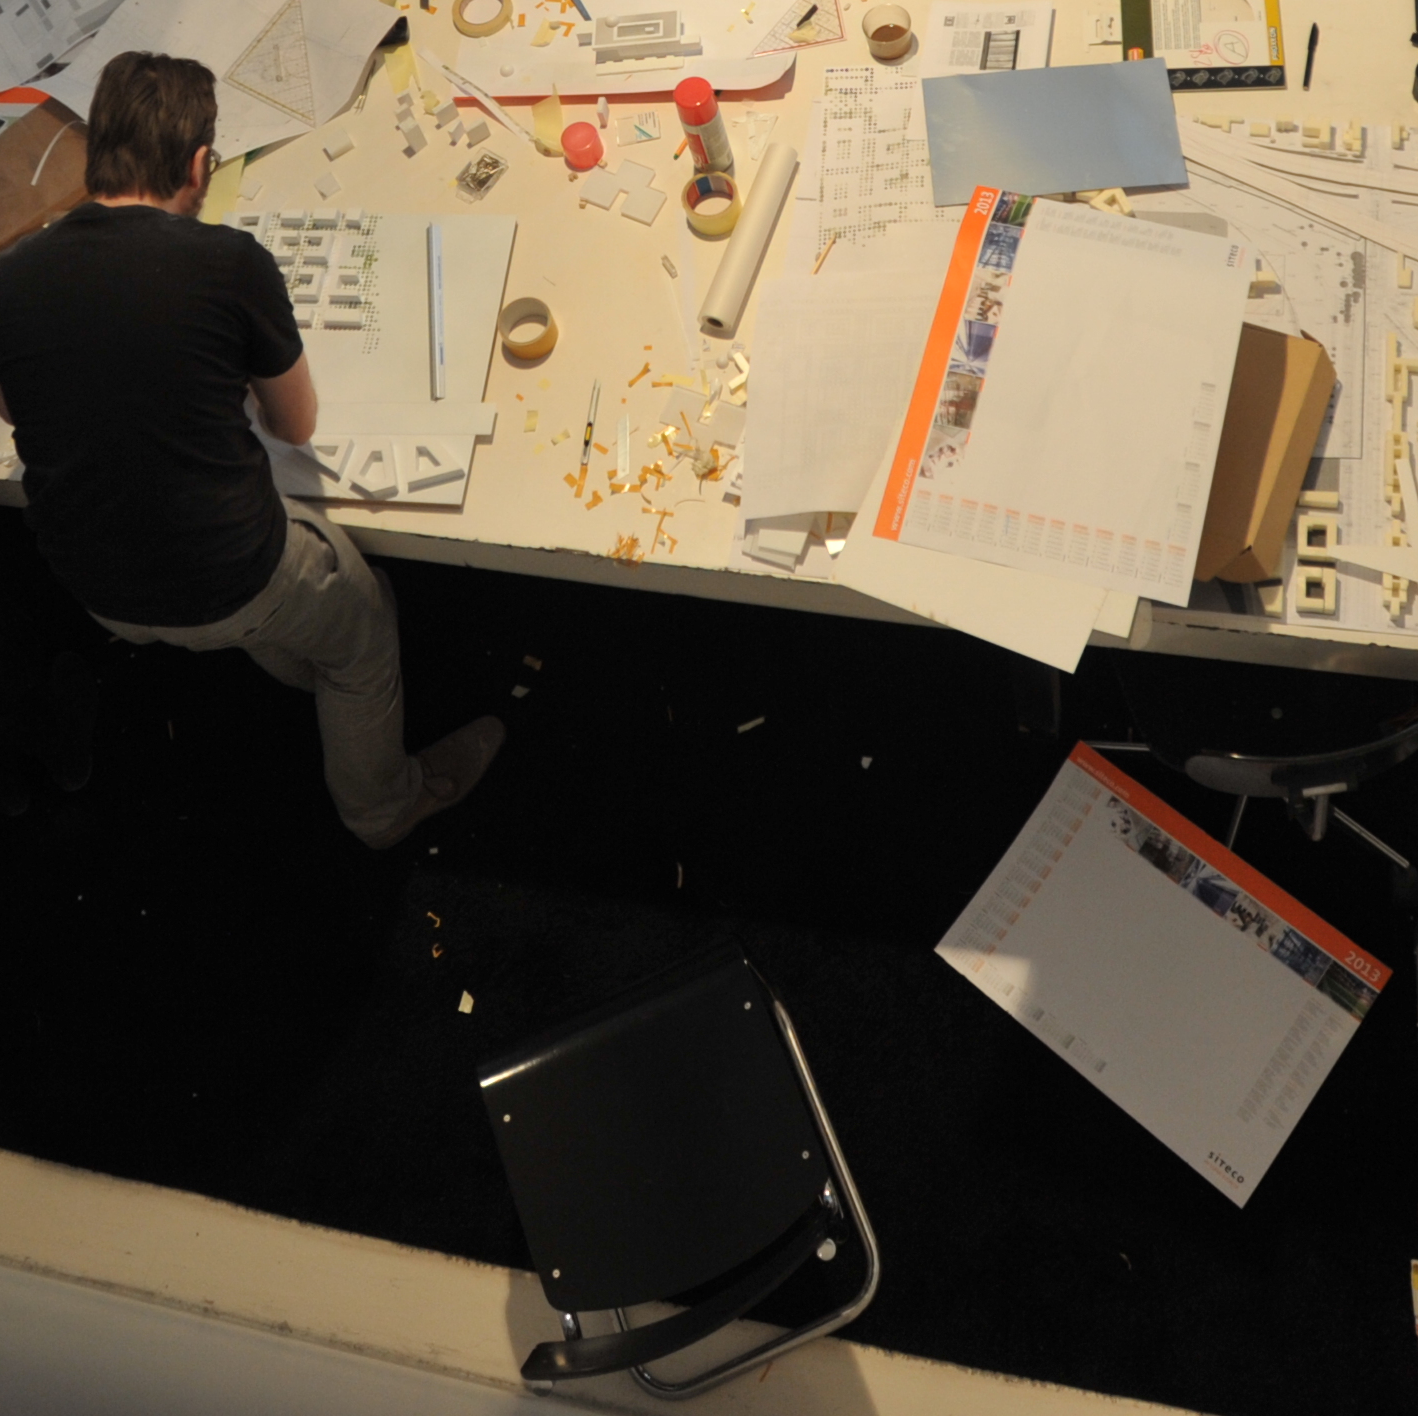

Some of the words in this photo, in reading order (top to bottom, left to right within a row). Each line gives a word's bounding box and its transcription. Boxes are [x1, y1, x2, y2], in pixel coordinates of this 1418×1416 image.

[973, 190, 995, 216] 2013
[889, 457, 917, 532] www.siteco.com
[1342, 949, 1383, 985] 2013
